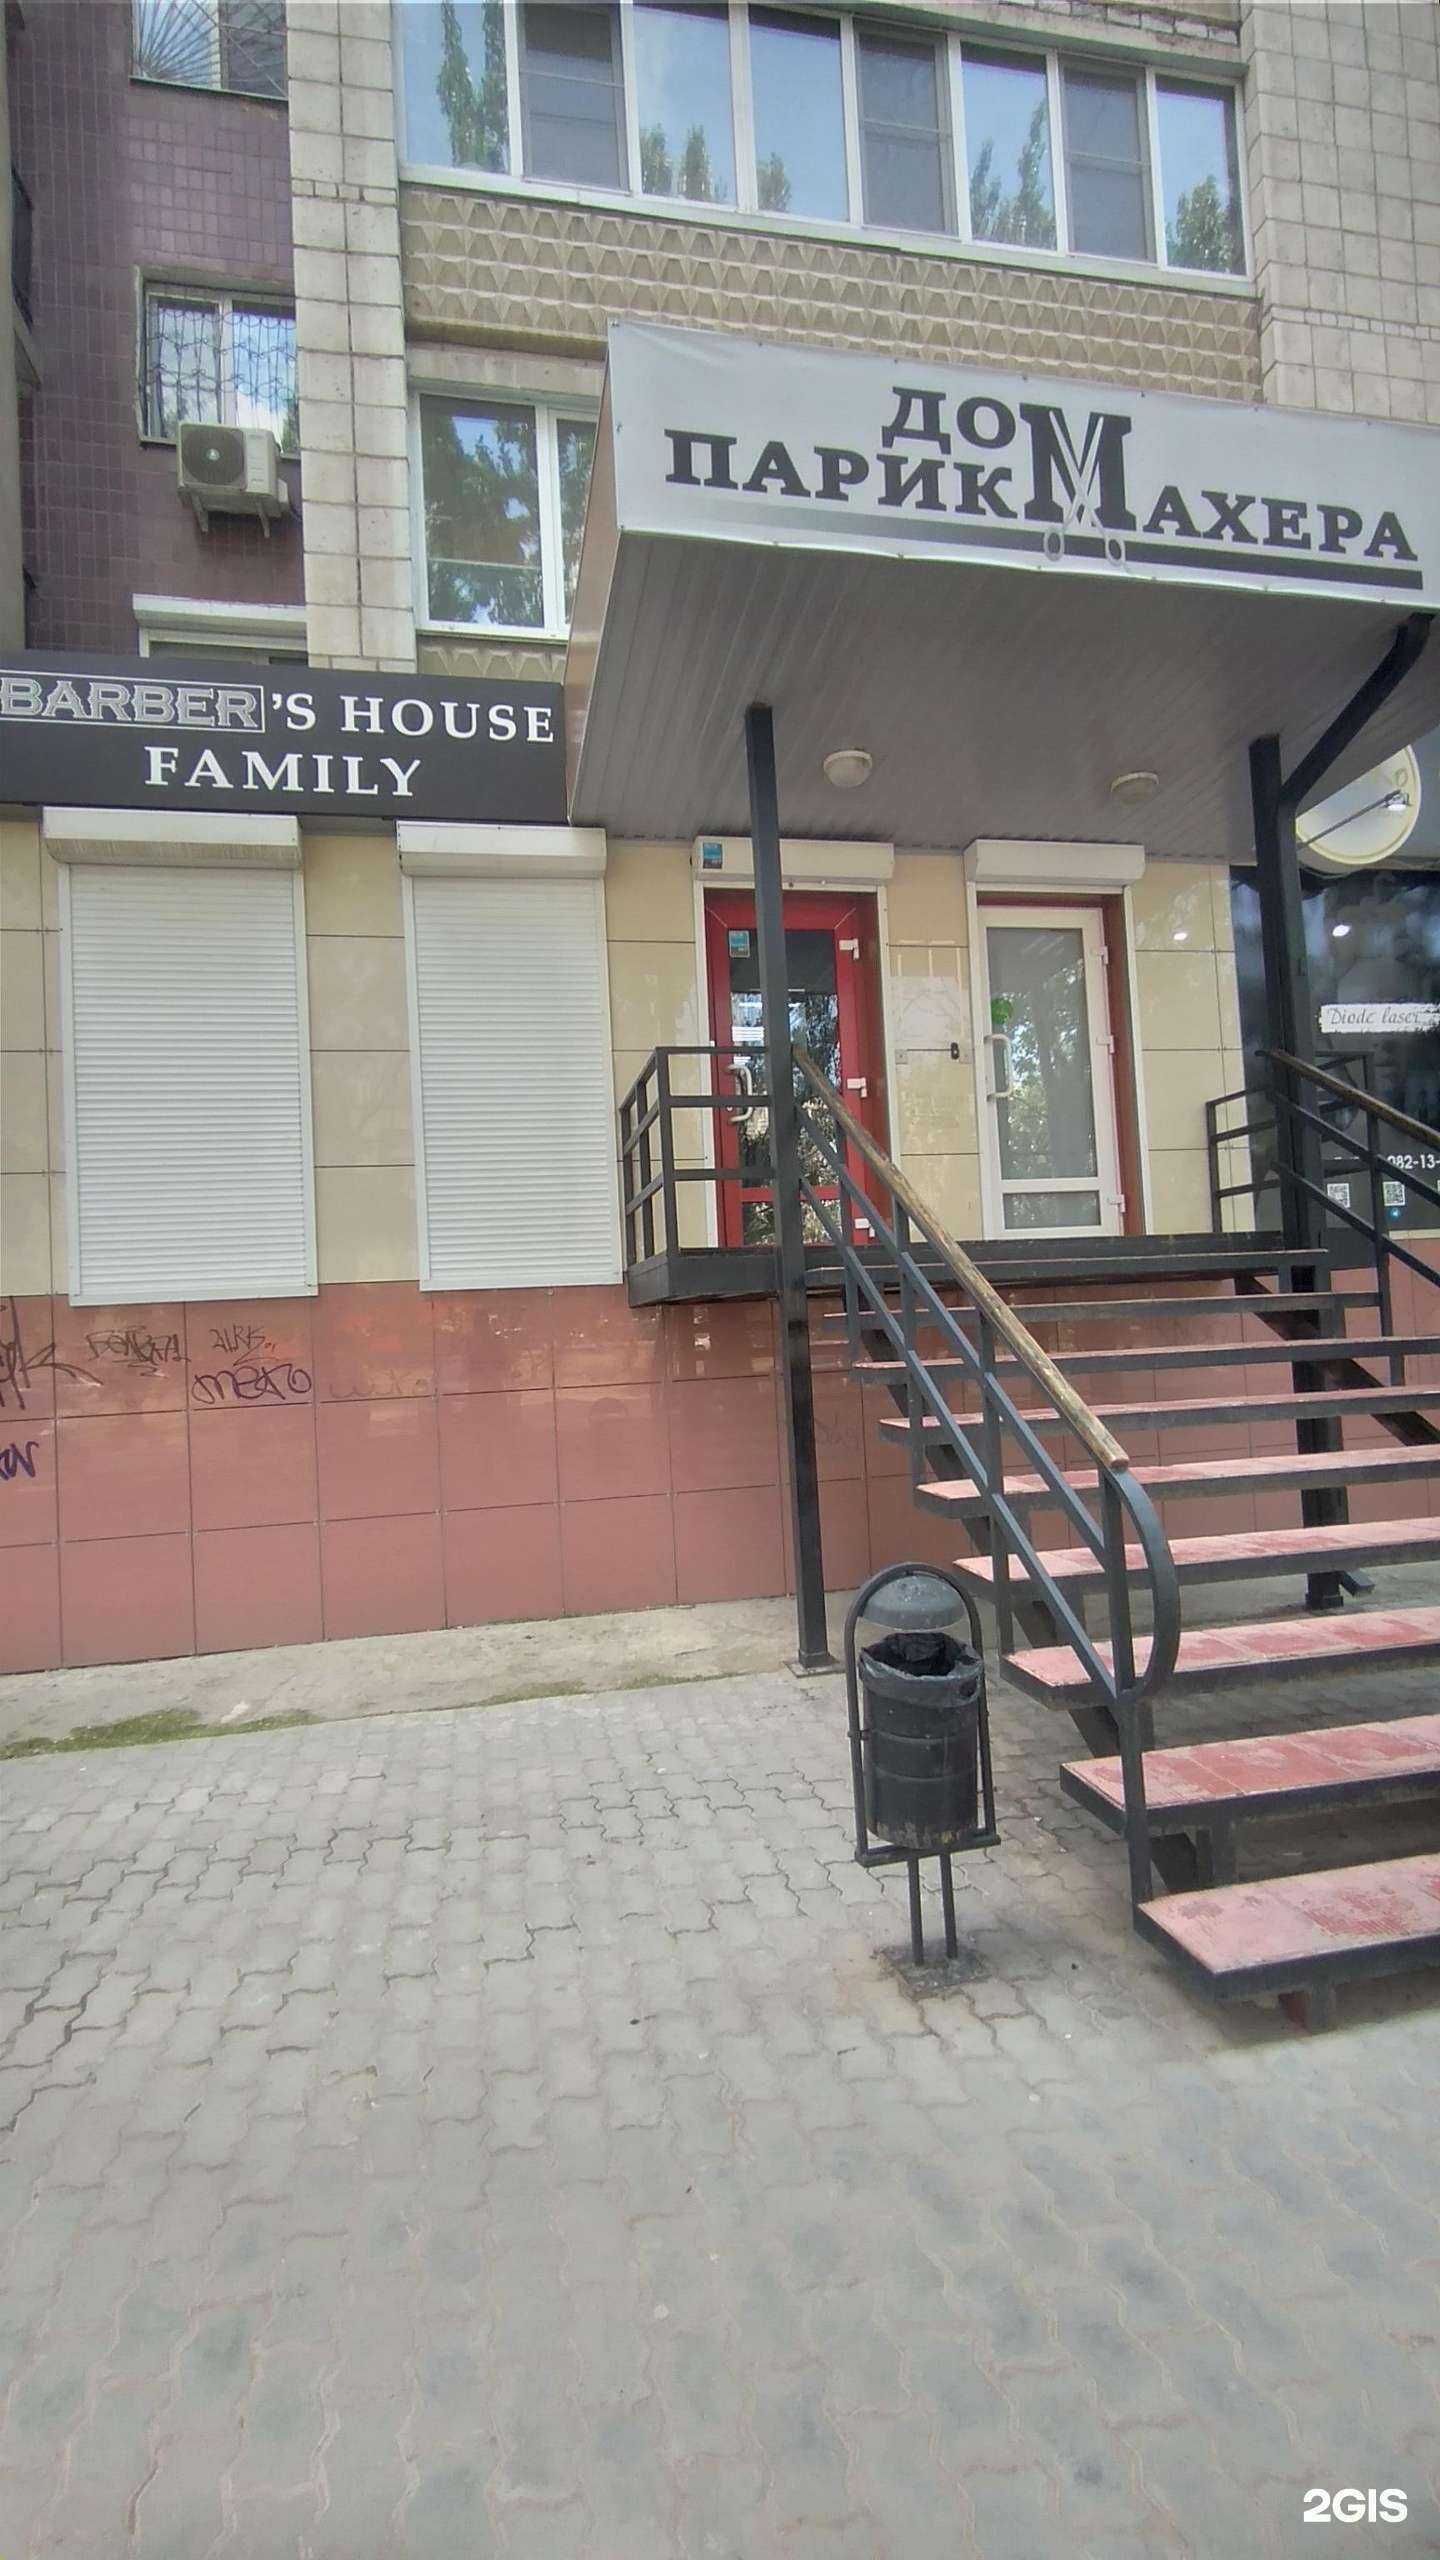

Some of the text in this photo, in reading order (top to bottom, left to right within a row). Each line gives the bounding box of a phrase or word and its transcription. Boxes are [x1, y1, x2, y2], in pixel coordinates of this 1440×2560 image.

[340, 695, 554, 742] HOUSE
[145, 746, 422, 797] FAMILY
[1328, 1007, 1376, 1025] Diode
